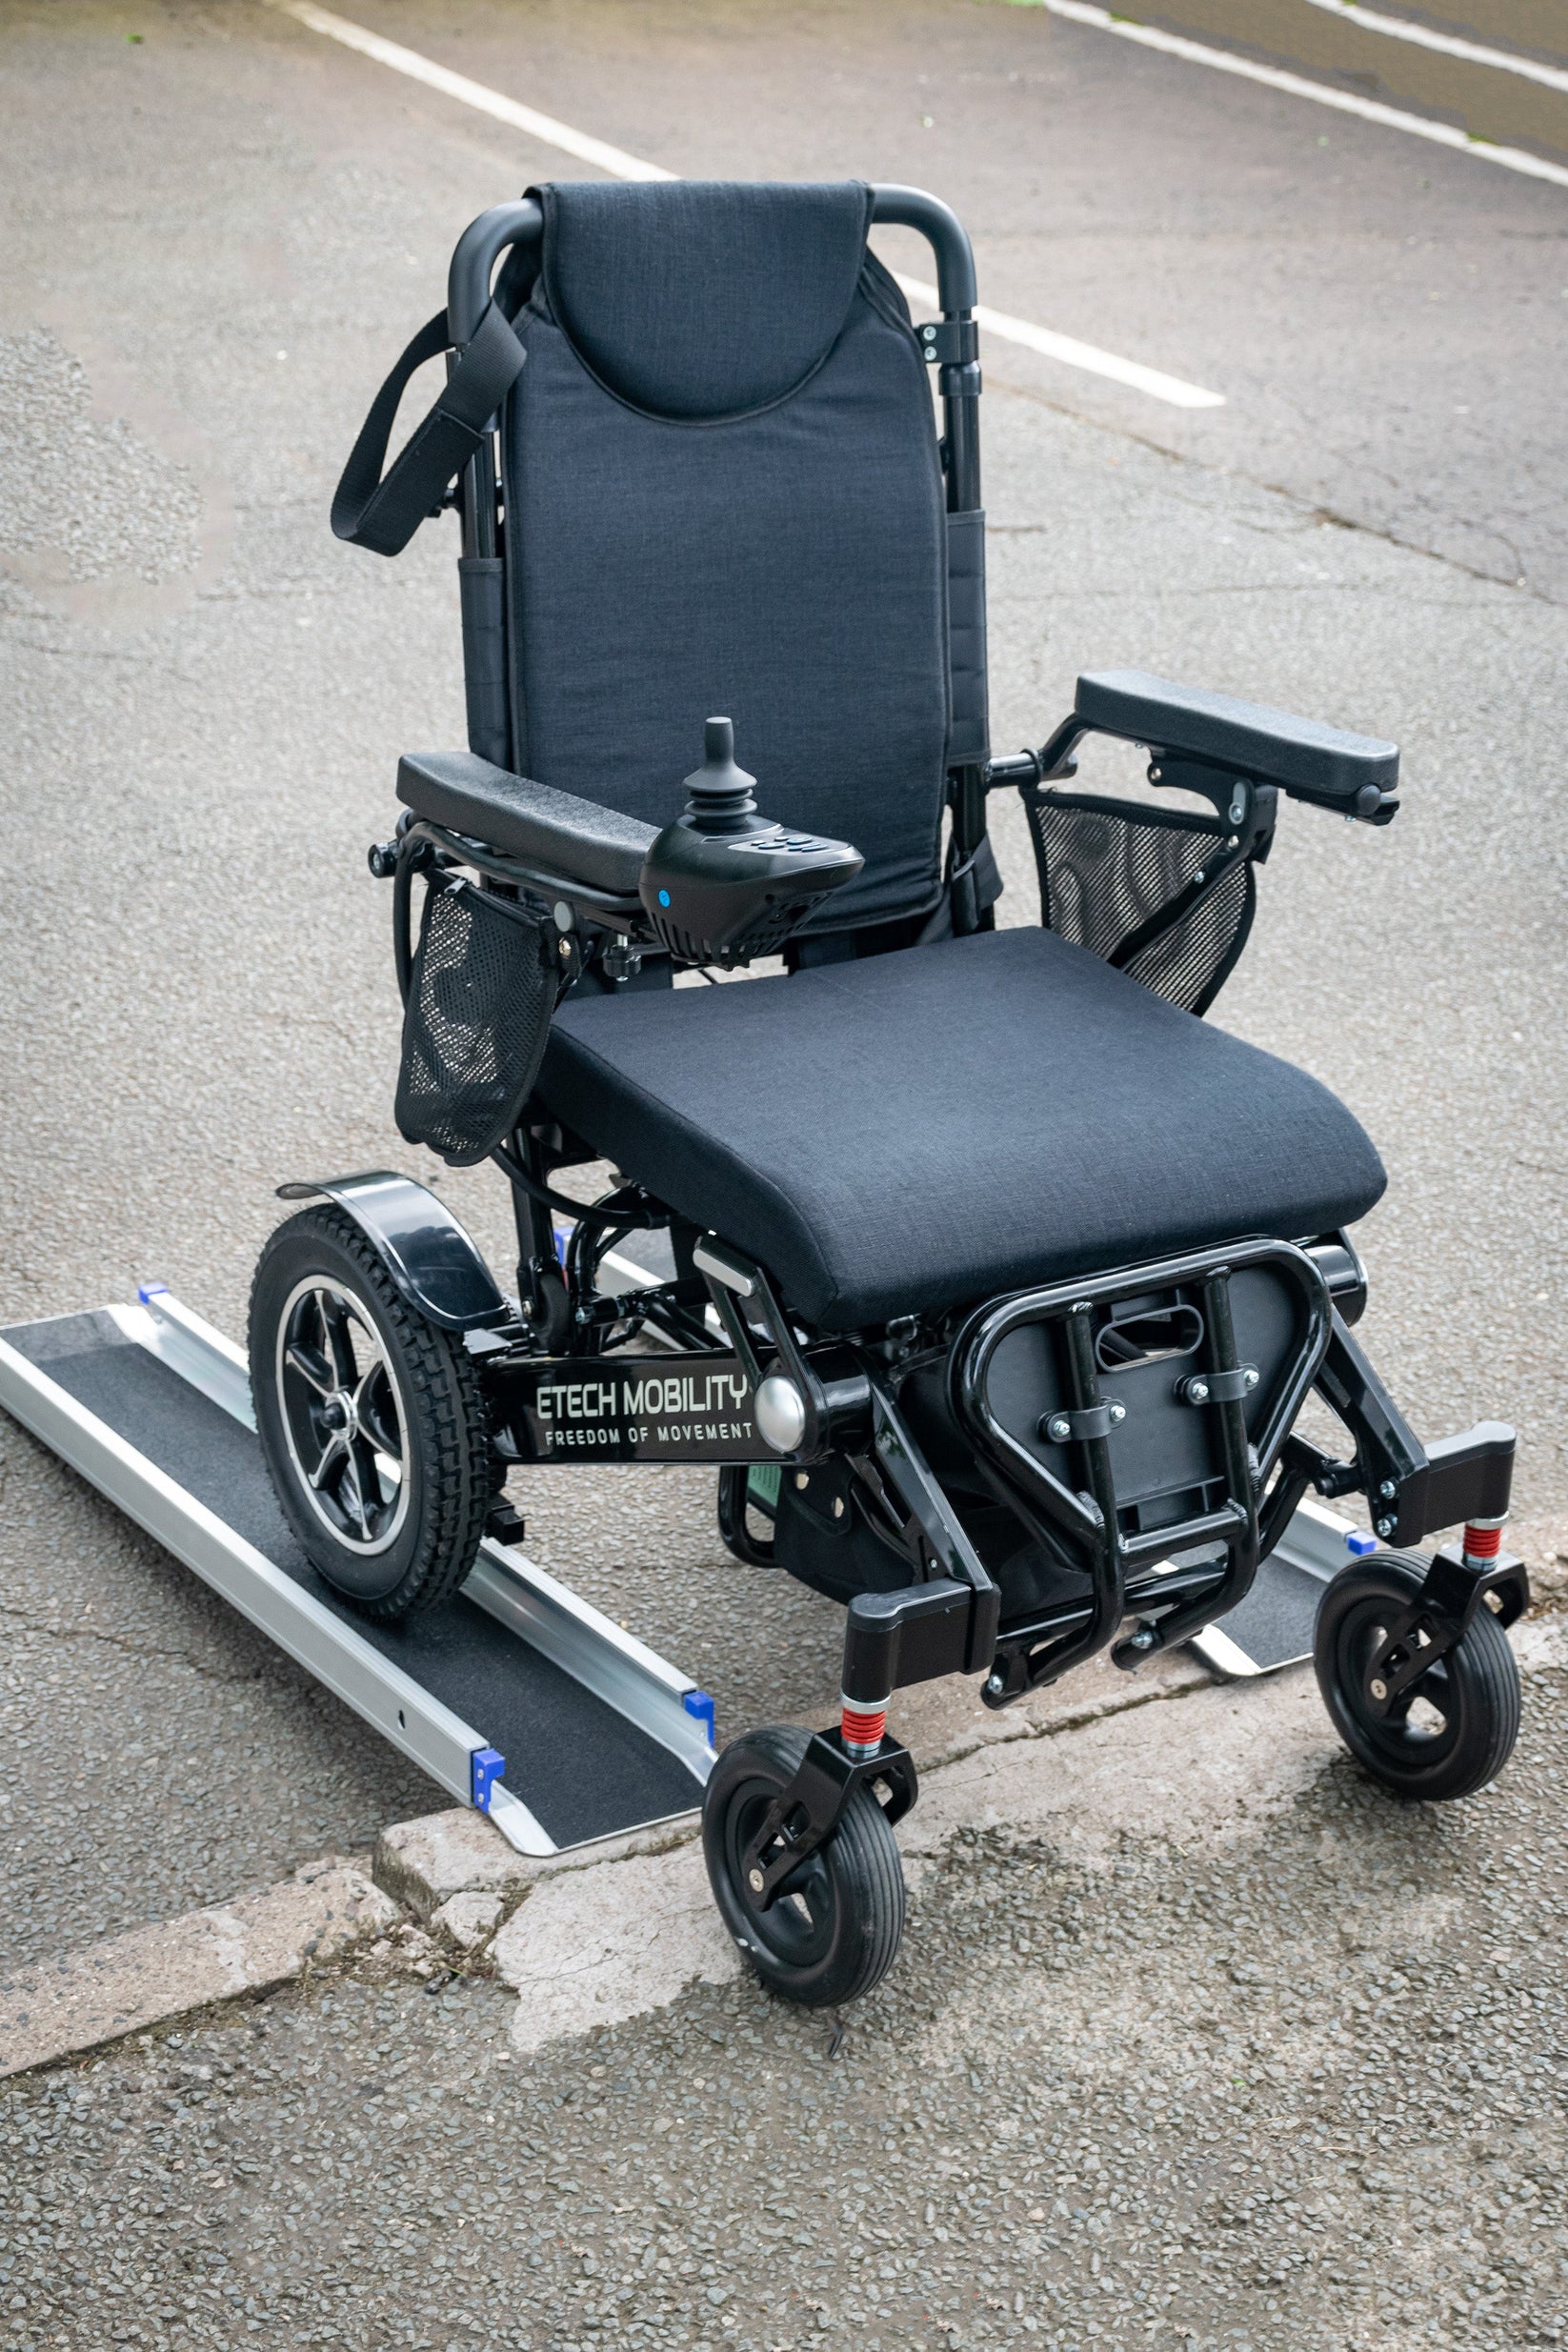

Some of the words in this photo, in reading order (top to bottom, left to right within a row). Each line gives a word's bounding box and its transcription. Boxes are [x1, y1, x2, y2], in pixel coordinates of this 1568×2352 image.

[536, 1381, 616, 1419] ETECH
[623, 1373, 748, 1416] MOBILITY
[545, 1428, 620, 1446] FREEDOM
[628, 1426, 649, 1443] OF
[657, 1421, 753, 1442] MOVEMENT
